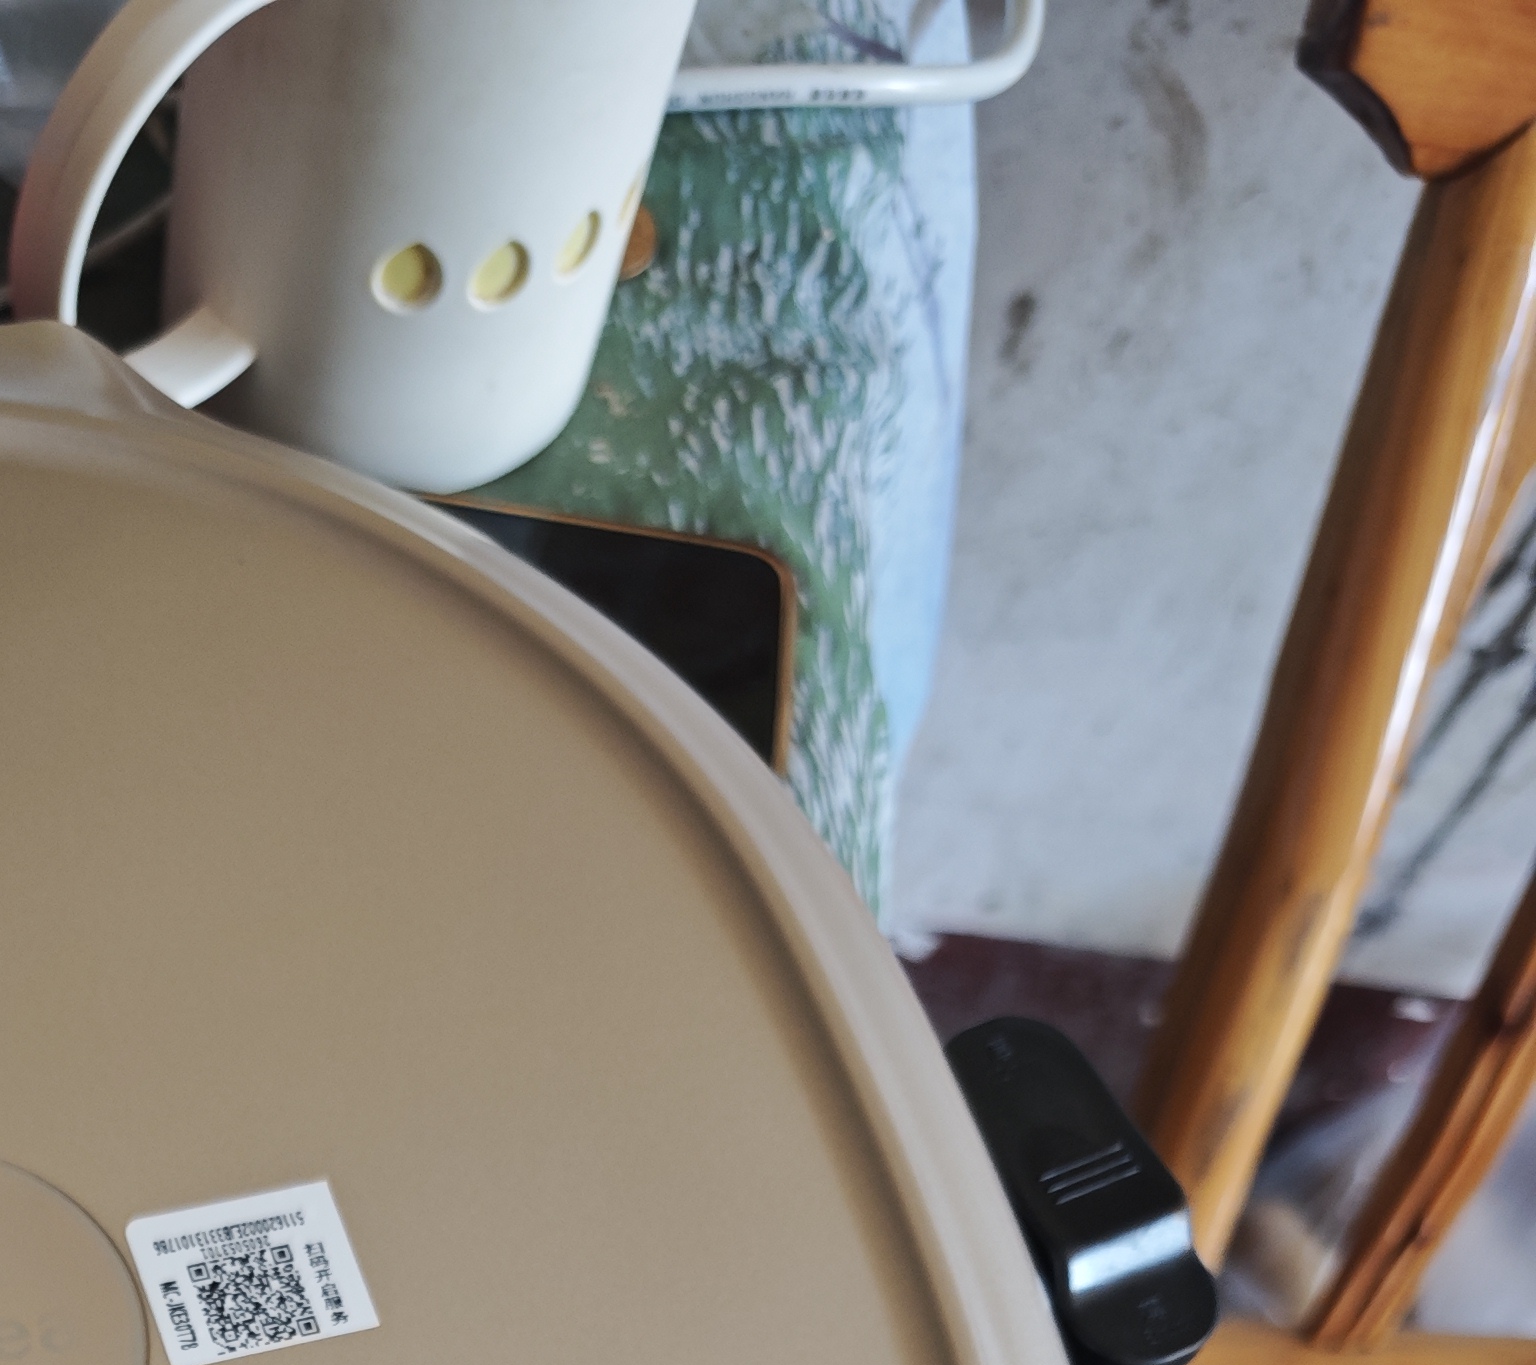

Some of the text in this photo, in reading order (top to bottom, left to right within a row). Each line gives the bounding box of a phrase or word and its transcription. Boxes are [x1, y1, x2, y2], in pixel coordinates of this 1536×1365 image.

[304, 1242, 349, 1326] 扫码开启服务
